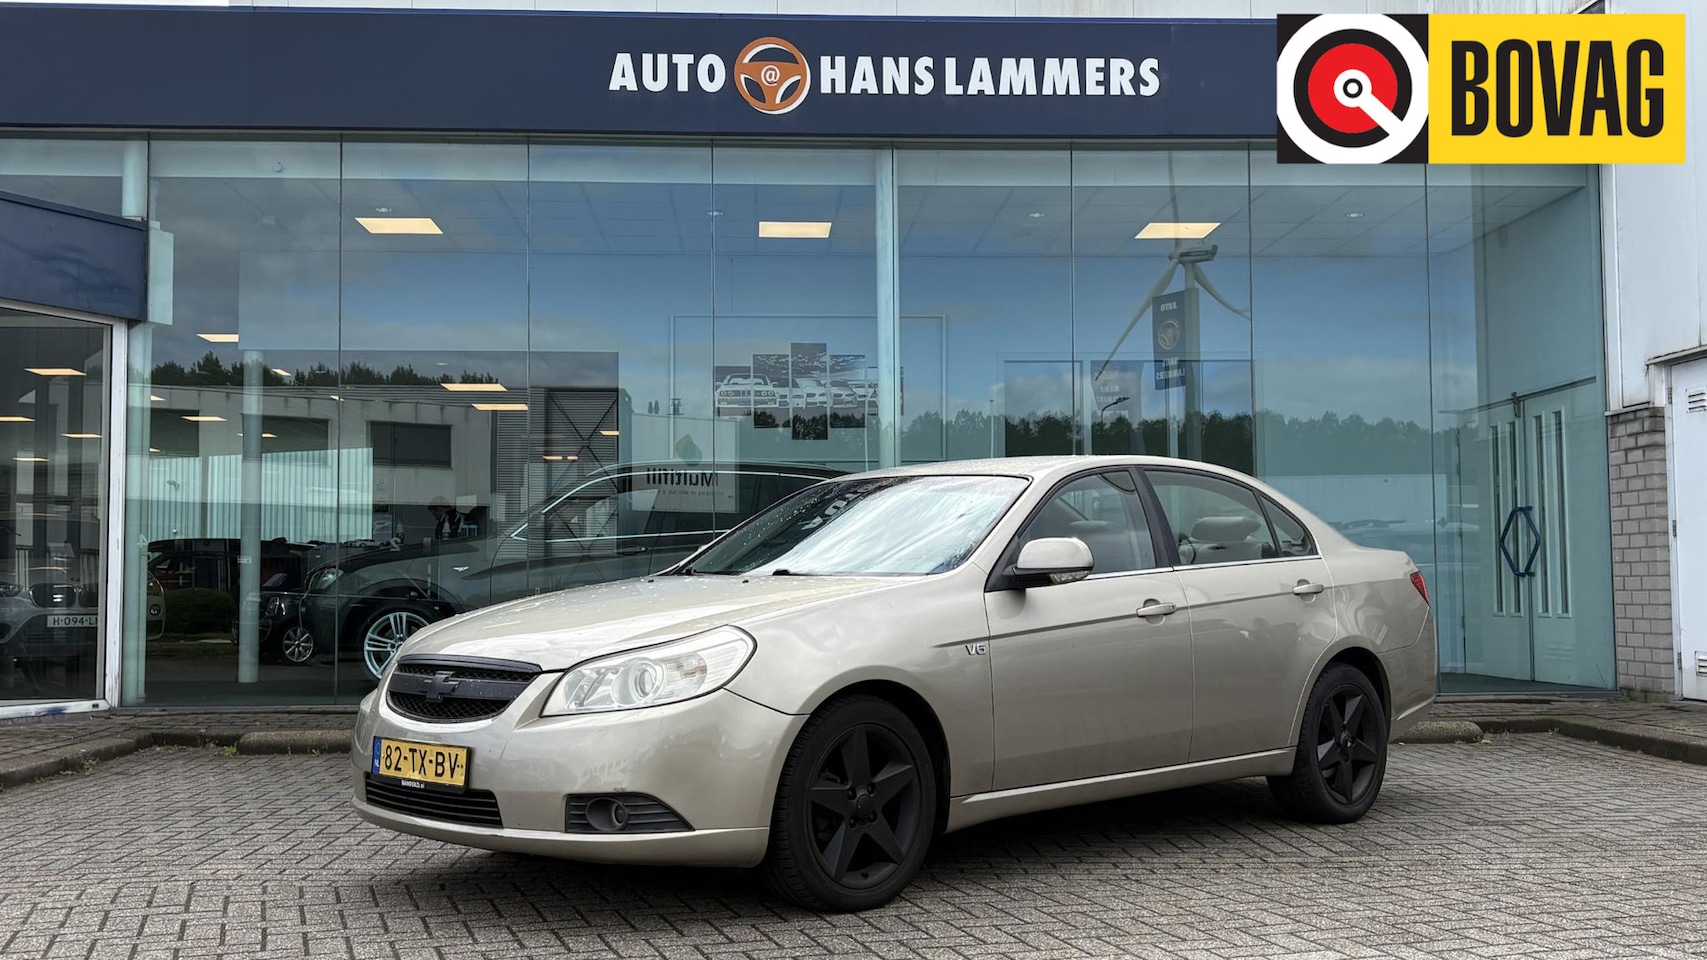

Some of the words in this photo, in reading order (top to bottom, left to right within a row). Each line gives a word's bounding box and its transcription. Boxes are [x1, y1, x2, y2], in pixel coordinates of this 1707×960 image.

[608, 52, 726, 93] AUTO
[761, 65, 780, 87] @
[820, 55, 935, 96] HANS
[944, 57, 1161, 97] LAMMERS
[965, 643, 987, 656] V6
[384, 744, 459, 779] 82-TX-BV
